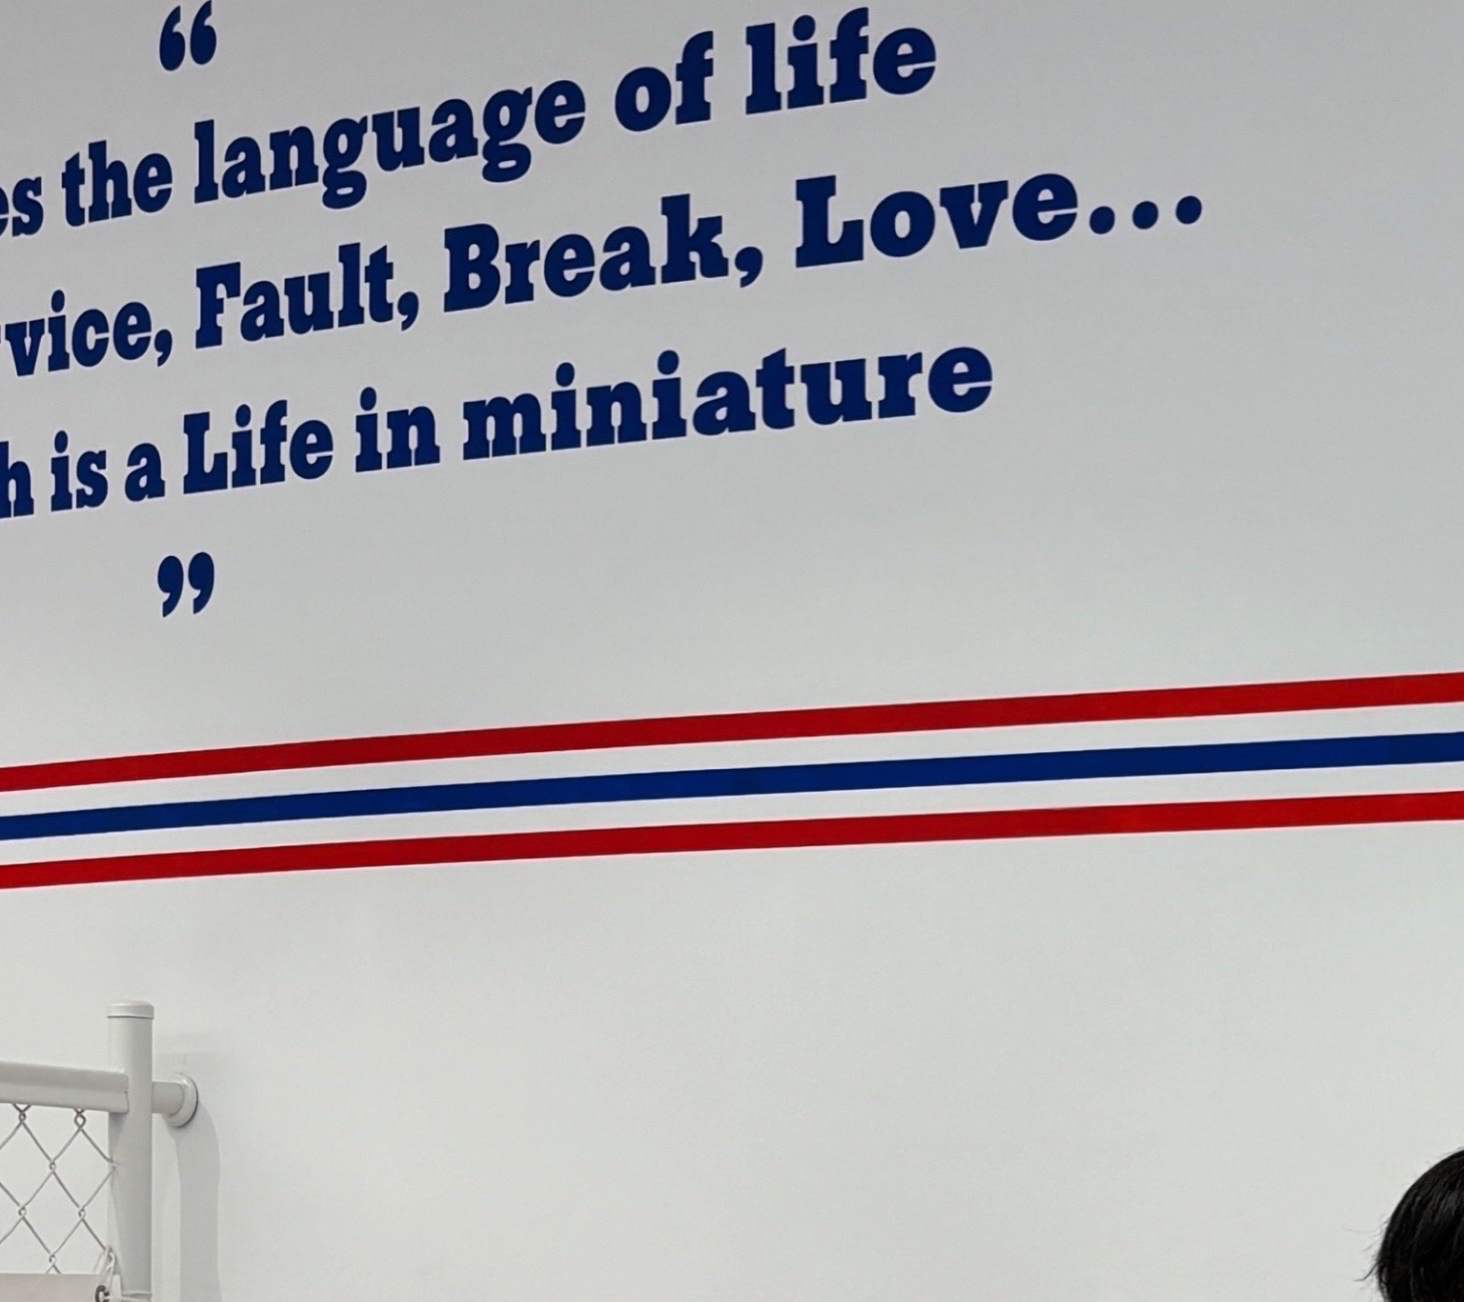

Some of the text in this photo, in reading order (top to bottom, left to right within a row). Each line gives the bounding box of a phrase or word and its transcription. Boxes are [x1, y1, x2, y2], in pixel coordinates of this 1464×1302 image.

[0, 6, 937, 238] s the language of life
[195, 242, 420, 349] Fault,
[443, 193, 764, 313] Break,
[50, 430, 109, 512] is
[124, 442, 166, 502] a
[183, 399, 335, 495] Life
[354, 386, 441, 473] in
[462, 346, 993, 461] miniature
